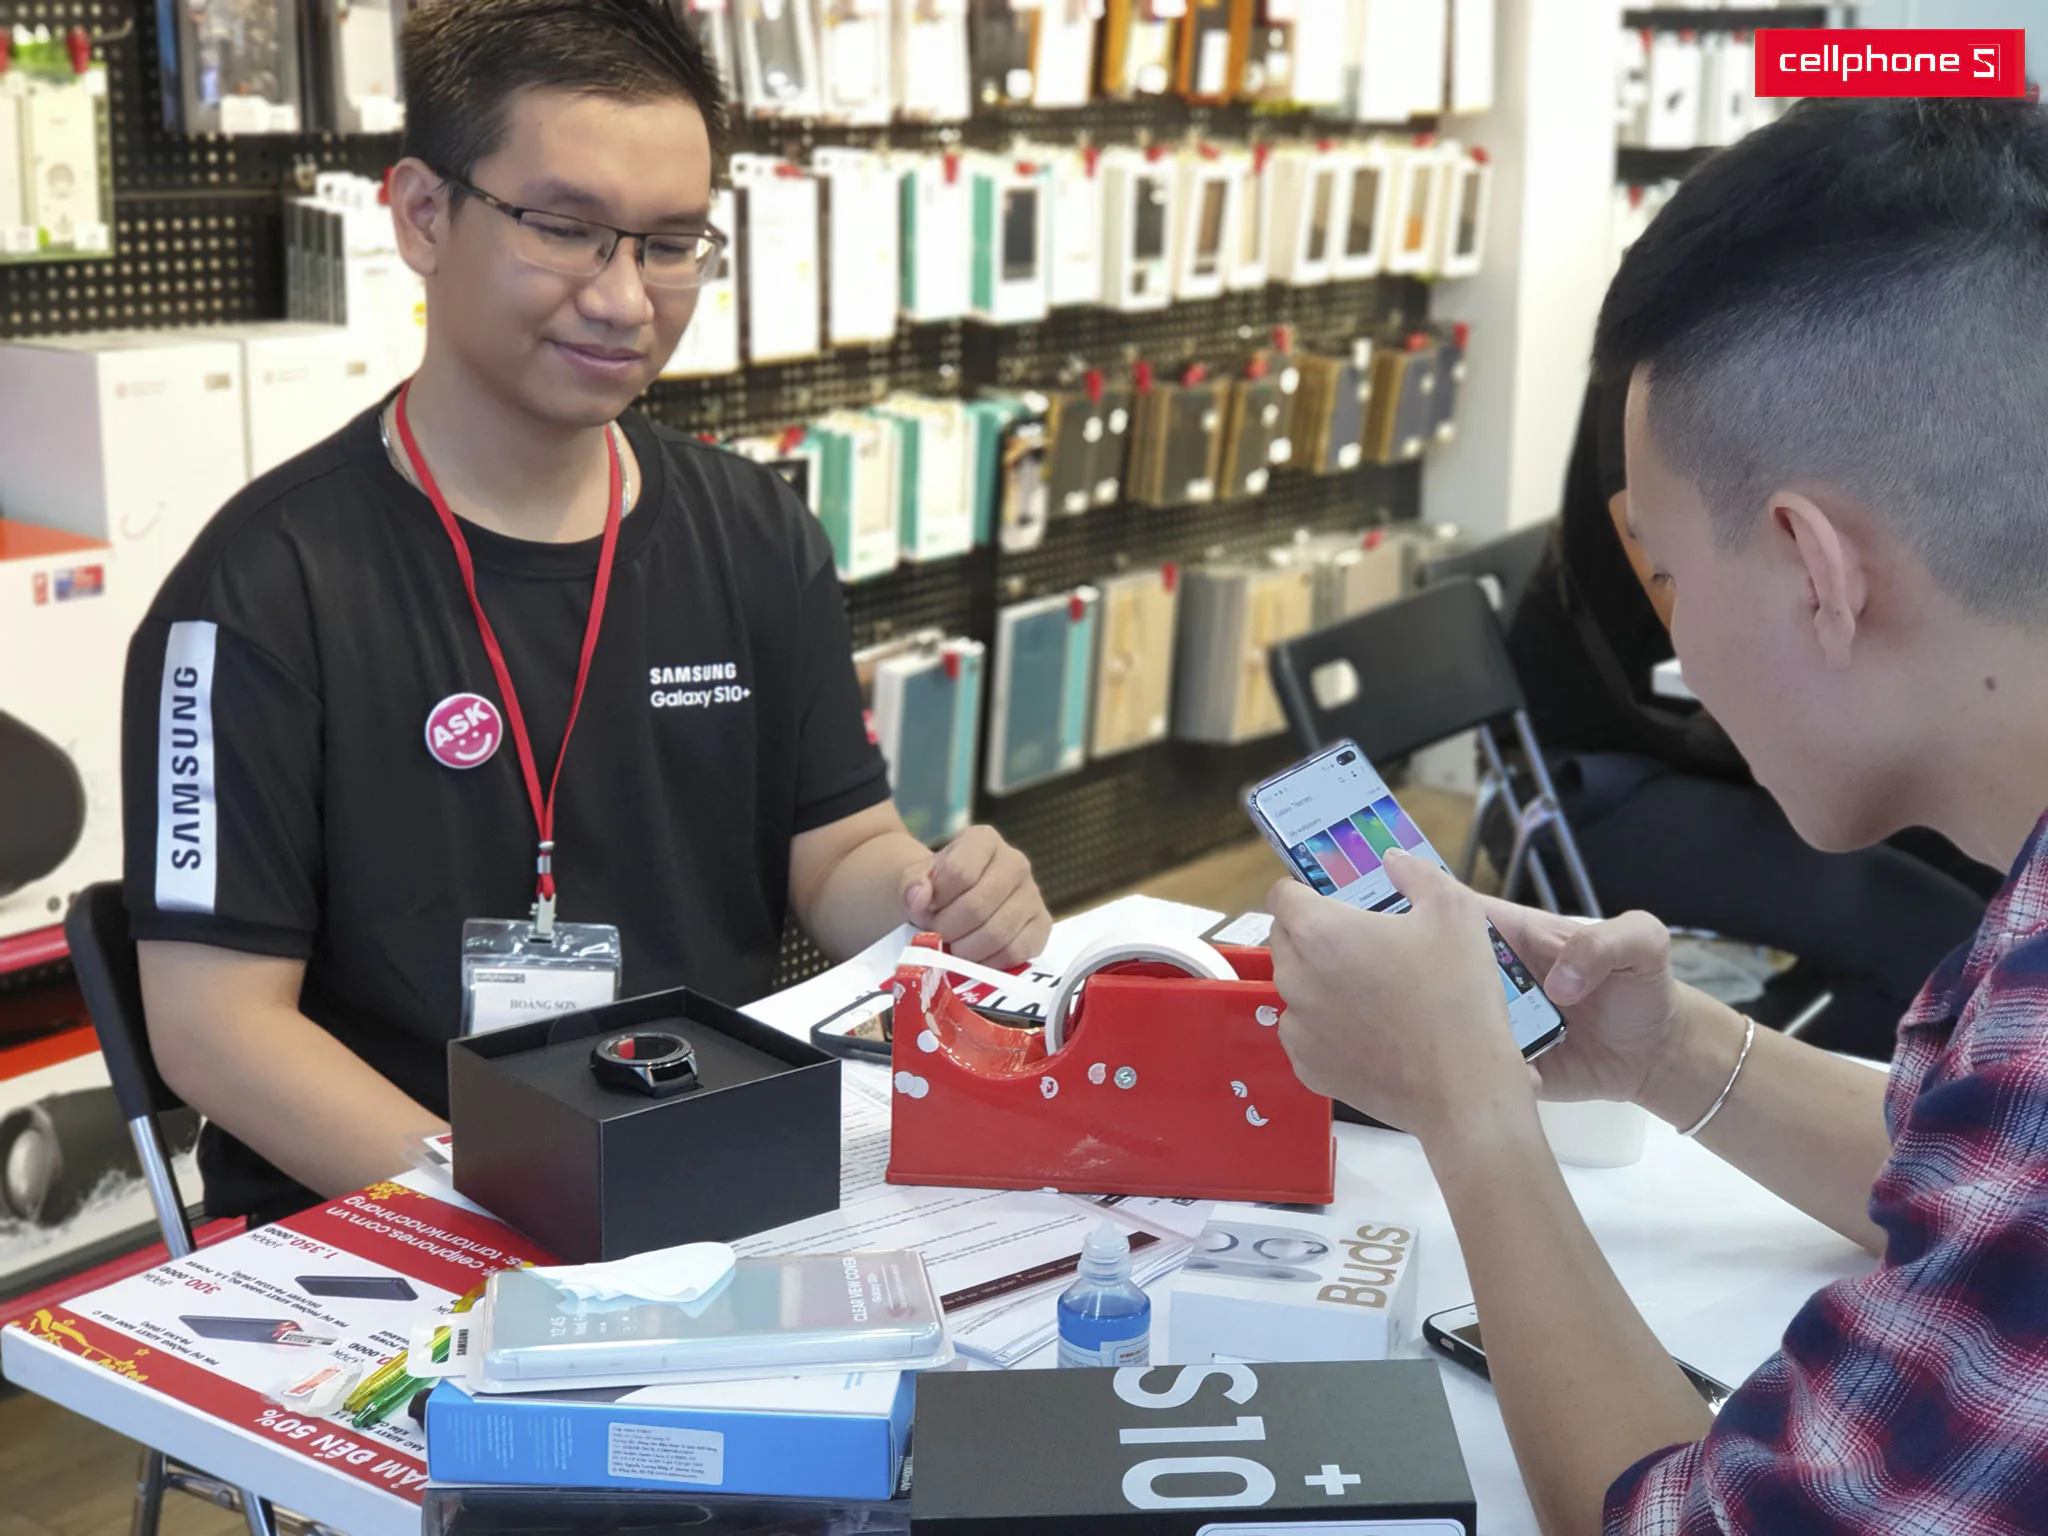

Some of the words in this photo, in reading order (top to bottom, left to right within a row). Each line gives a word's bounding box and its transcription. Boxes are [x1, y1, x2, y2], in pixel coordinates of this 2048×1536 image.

[649, 662, 737, 685] SAMSUNG
[650, 688, 712, 708] Galaxy
[713, 685, 751, 703] S10+
[433, 700, 491, 749] ASK
[172, 666, 202, 870] SAMSUNG
[510, 999, 552, 1011] HOÀNG
[326, 1206, 485, 1270] cellphones.com.vn
[344, 1196, 503, 1259] tantamkhachhang
[842, 1256, 860, 1280] COVER
[1316, 1224, 1411, 1310] Buds
[847, 1280, 863, 1300] VIEW
[850, 1299, 868, 1321] CLEAR
[456, 1328, 469, 1356] SAMSUNG
[254, 1408, 318, 1440] 50%
[309, 1433, 378, 1466] ĐẾN
